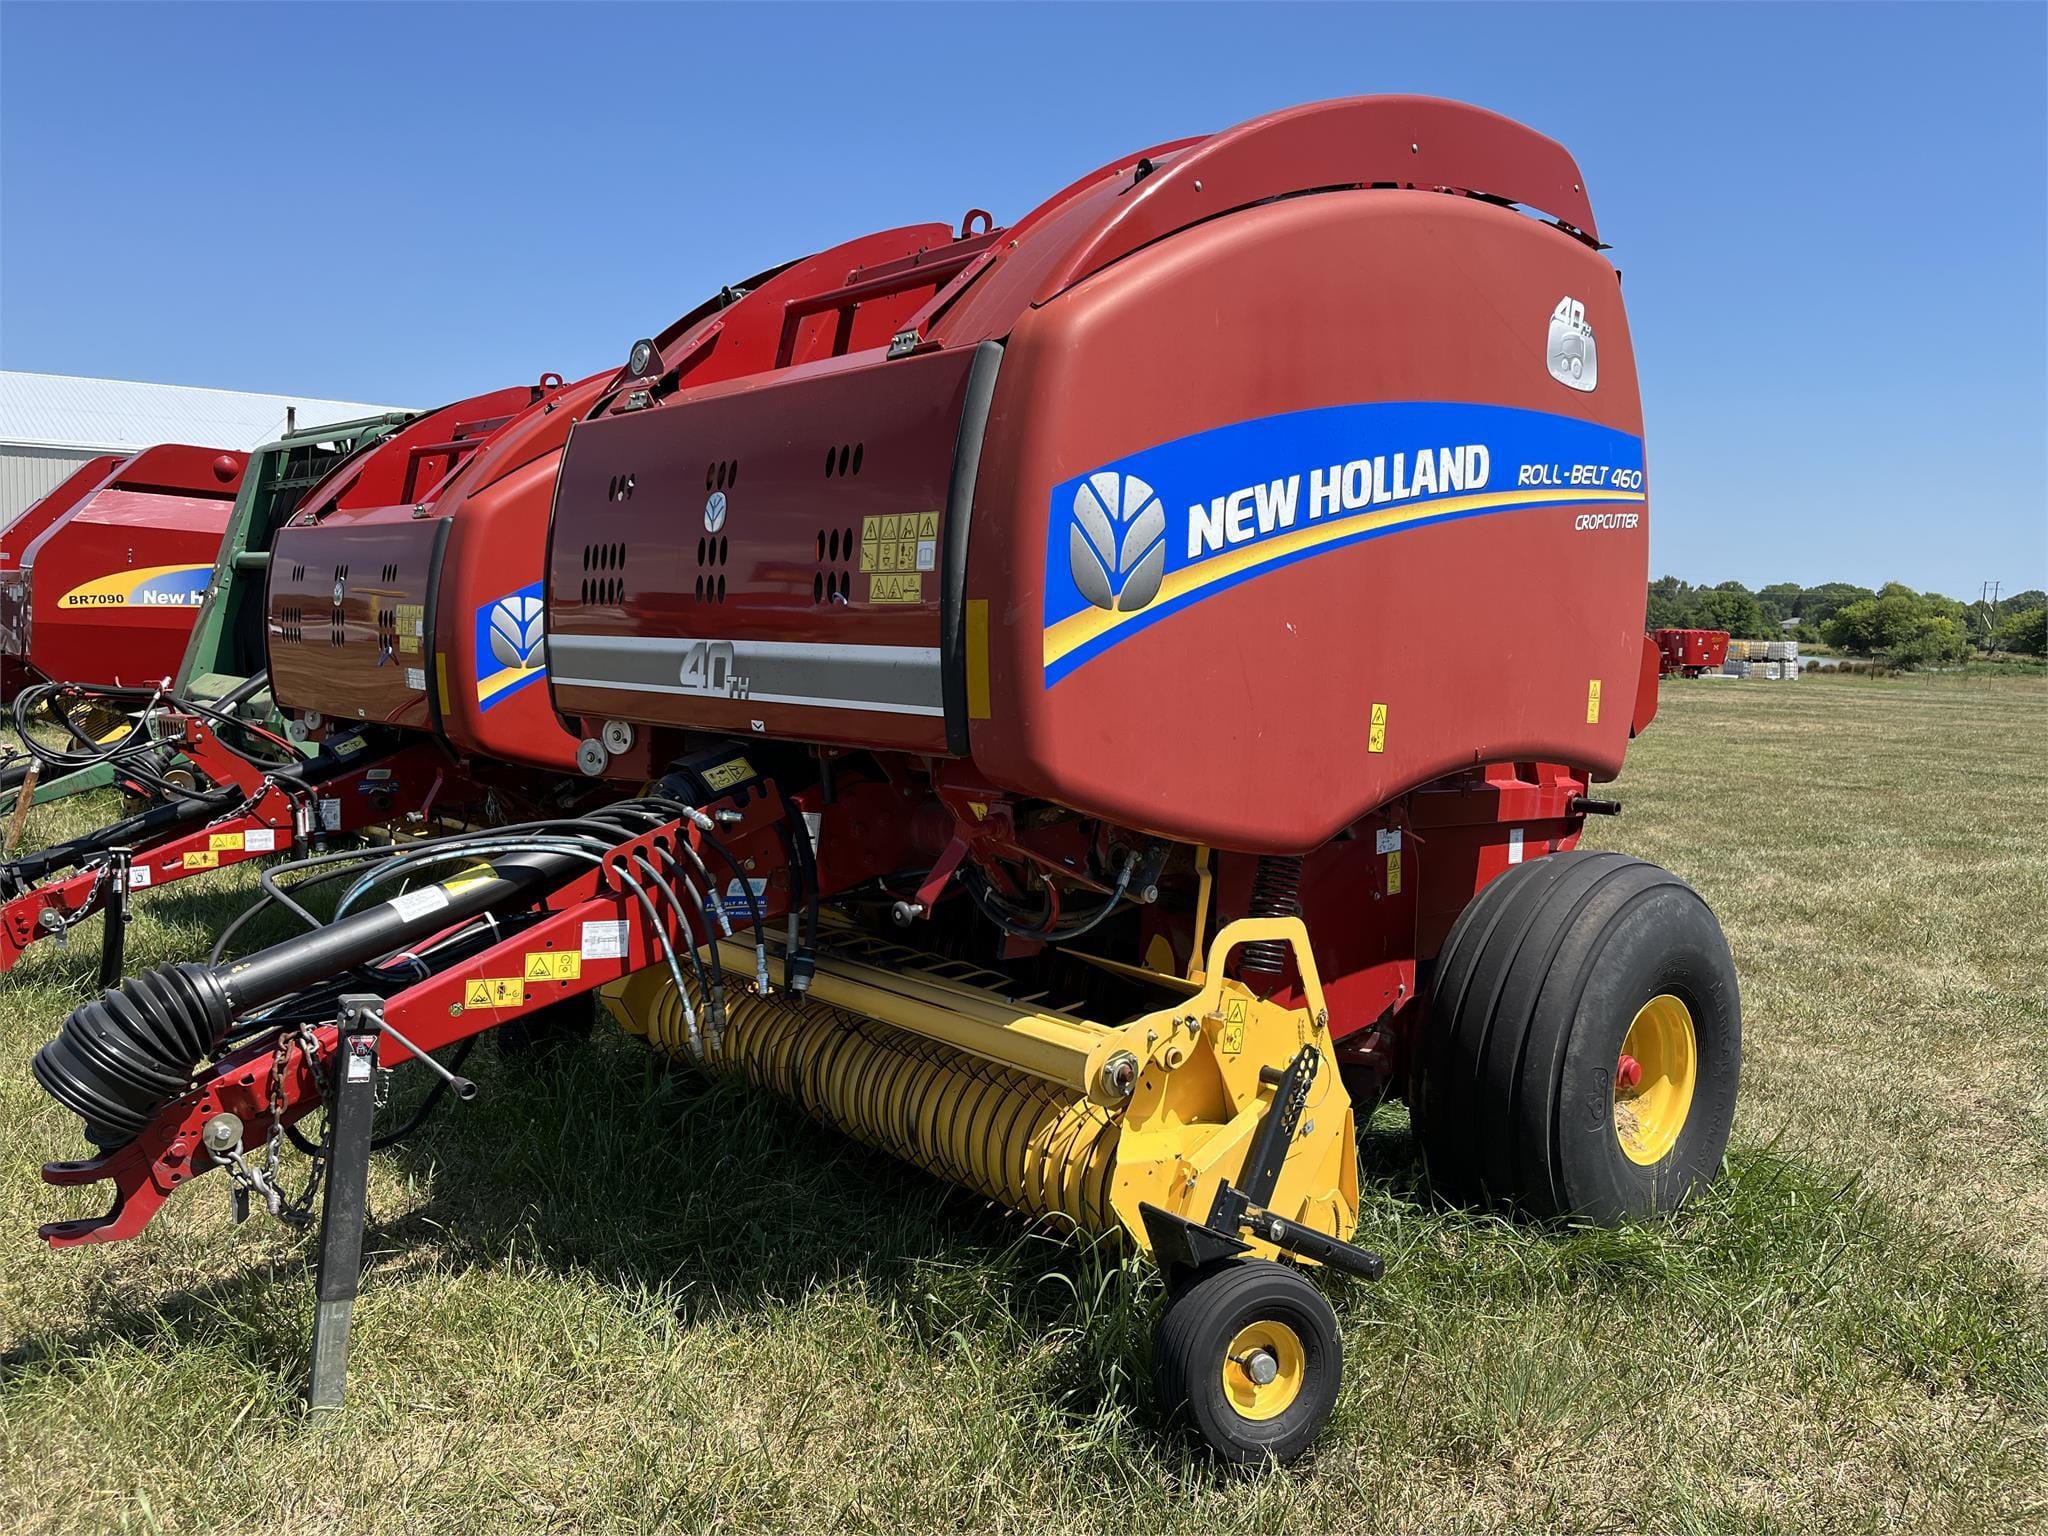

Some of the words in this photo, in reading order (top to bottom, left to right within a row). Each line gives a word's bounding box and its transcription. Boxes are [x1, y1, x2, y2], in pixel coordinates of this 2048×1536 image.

[1517, 464, 1609, 486] ROLL-BELT
[1611, 468, 1642, 489] 460
[1187, 474, 1301, 559] NEW
[1309, 444, 1490, 519] HOLLAND
[1574, 513, 1639, 531] CROPCUTTER
[68, 594, 125, 605] BR7090
[143, 590, 184, 604] New
[680, 641, 749, 698] 40TH
